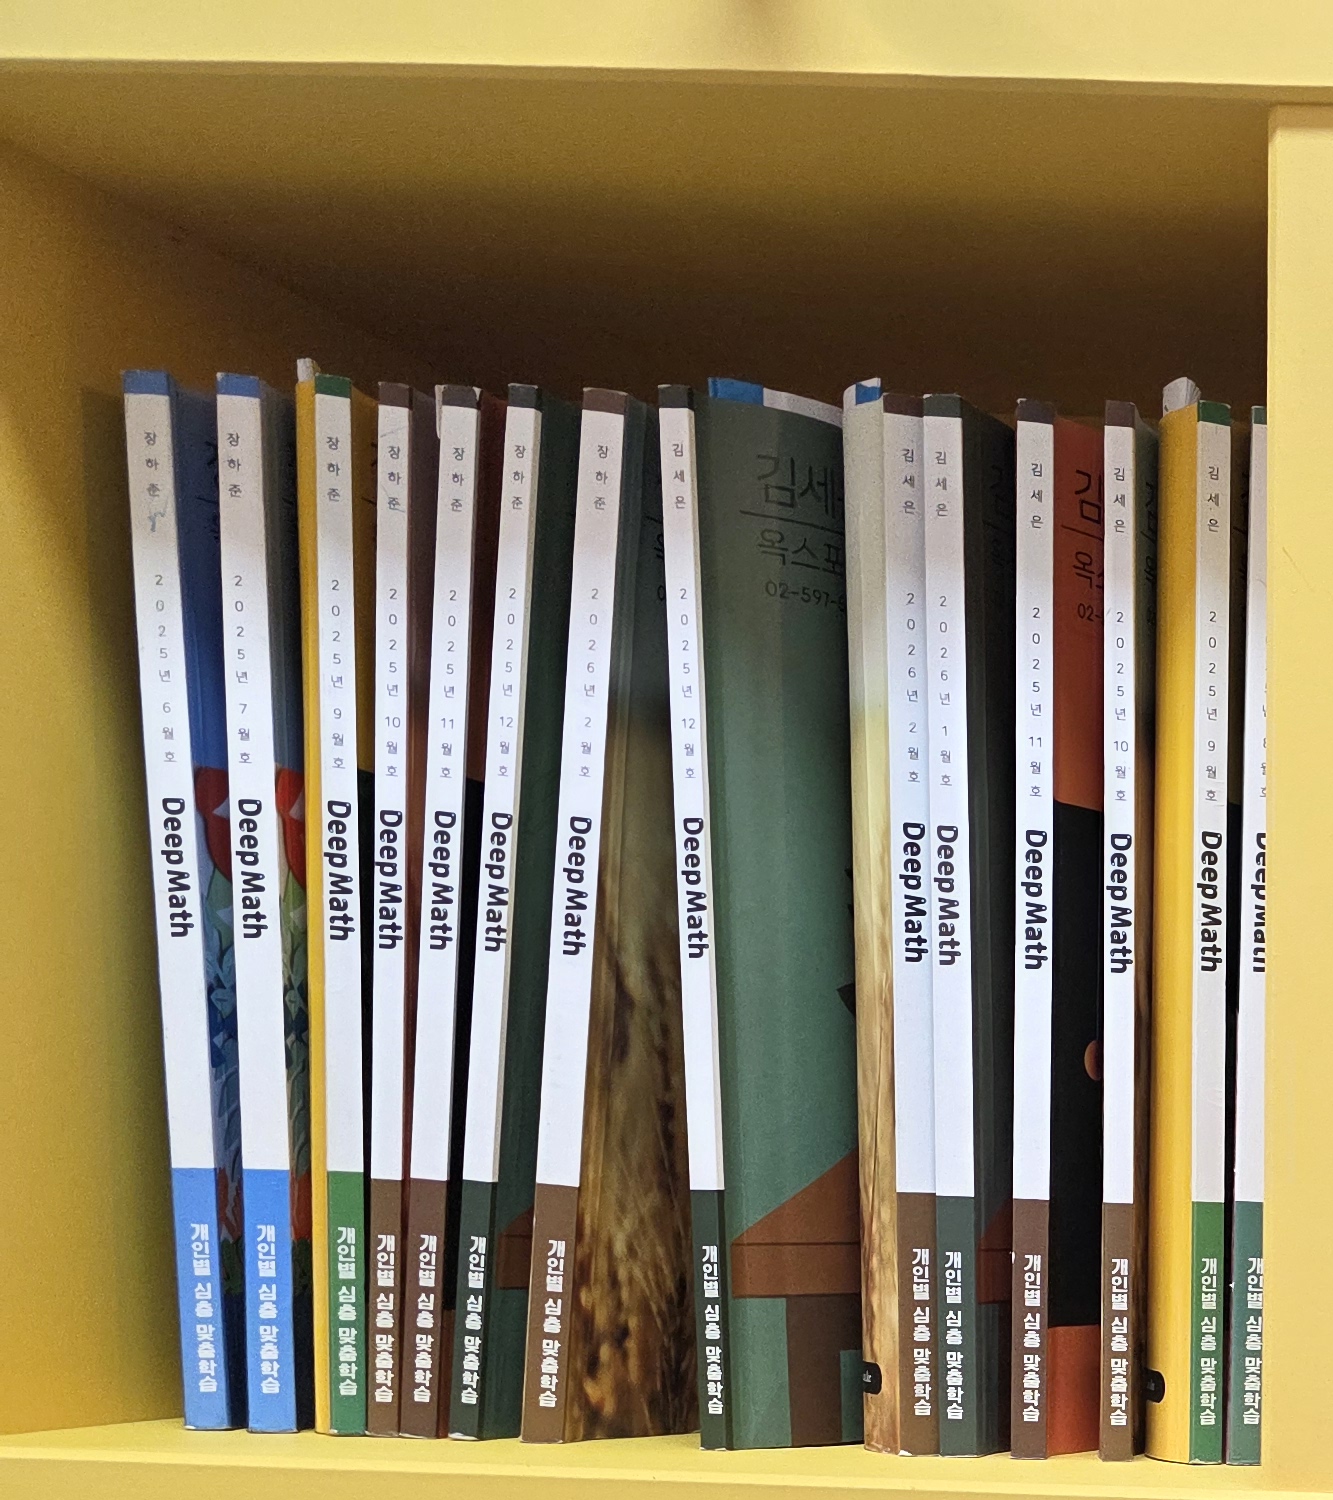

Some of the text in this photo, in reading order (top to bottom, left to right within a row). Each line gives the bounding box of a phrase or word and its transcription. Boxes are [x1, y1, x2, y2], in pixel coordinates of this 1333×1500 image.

[593, 444, 610, 512] 장하준
[757, 453, 843, 520] 김세
[934, 450, 949, 518] 김세은
[190, 1222, 219, 1394] 개인별 심층 맞춤학습
[537, 1239, 567, 1409] 개인별 심층 맞춤학습
[944, 1251, 966, 1421] 개인별 심층 맞춤학습
